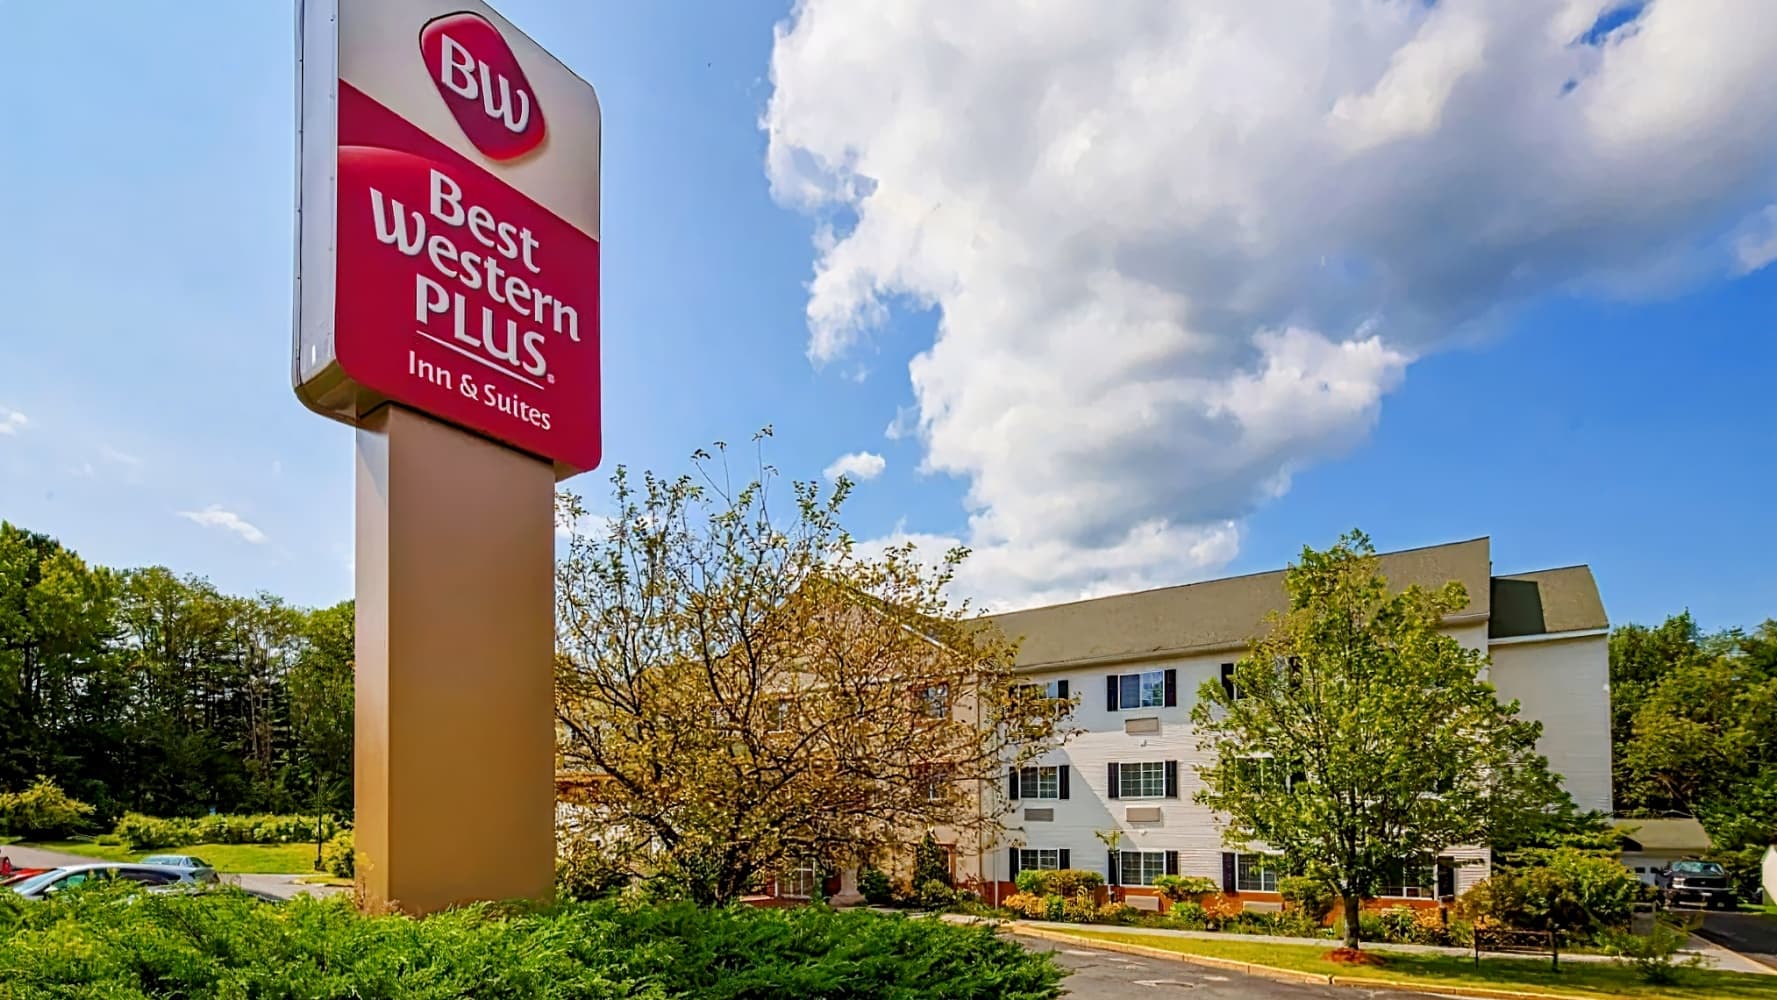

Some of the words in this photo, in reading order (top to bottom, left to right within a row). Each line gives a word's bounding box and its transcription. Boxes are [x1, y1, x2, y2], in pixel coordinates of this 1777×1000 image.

[441, 34, 529, 133] BW
[369, 187, 582, 342] Western
[430, 169, 540, 274] Best
[416, 273, 547, 377] PLUS
[409, 350, 453, 389] Inn
[460, 375, 479, 400] &
[484, 387, 551, 430] Suites
